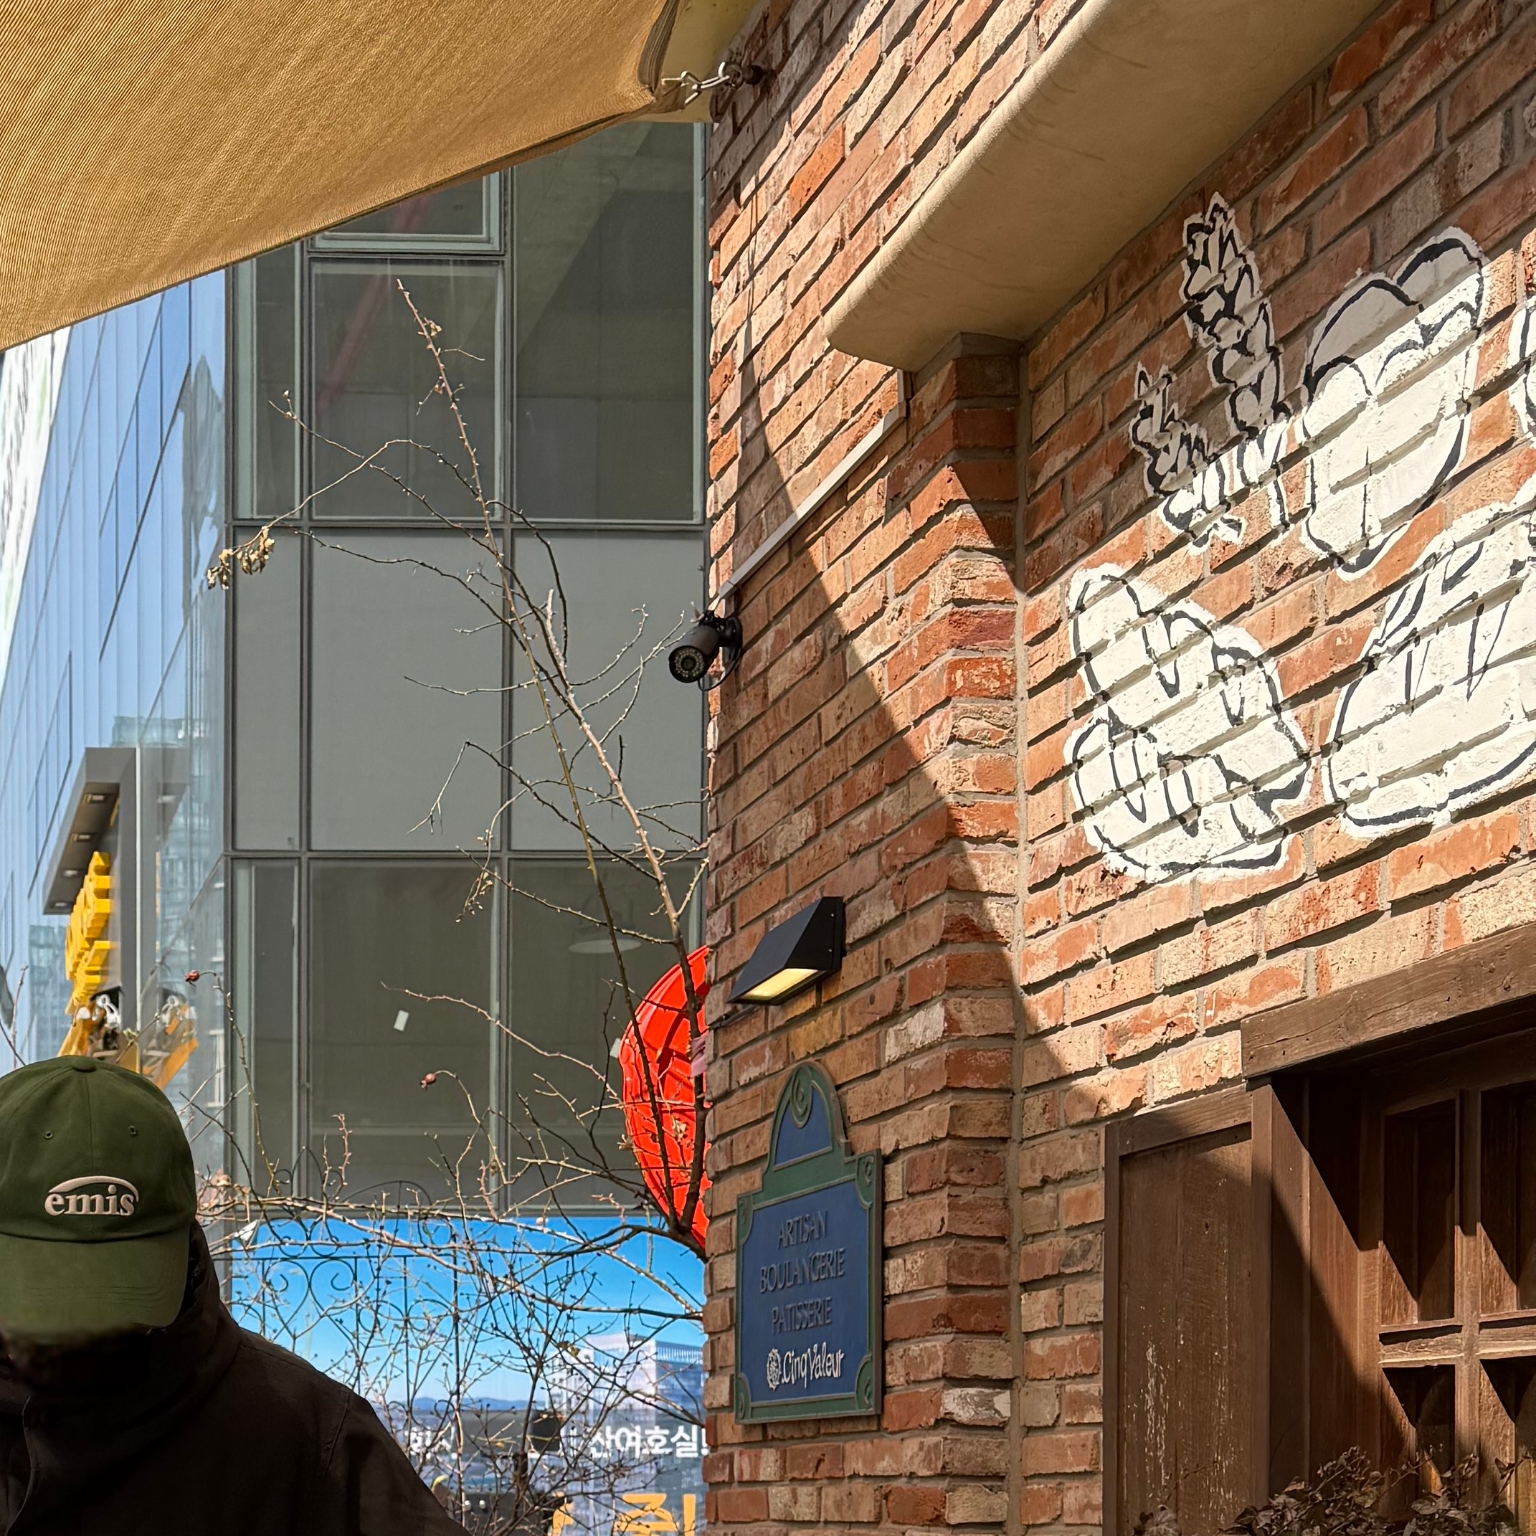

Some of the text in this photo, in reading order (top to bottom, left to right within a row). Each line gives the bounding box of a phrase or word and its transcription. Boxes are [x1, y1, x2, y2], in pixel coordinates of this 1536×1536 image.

[45, 1184, 135, 1216] emis
[778, 1210, 828, 1250] ARTISAN
[760, 1248, 845, 1294] BOULANGERIE
[771, 1296, 832, 1335] PATISSERIE
